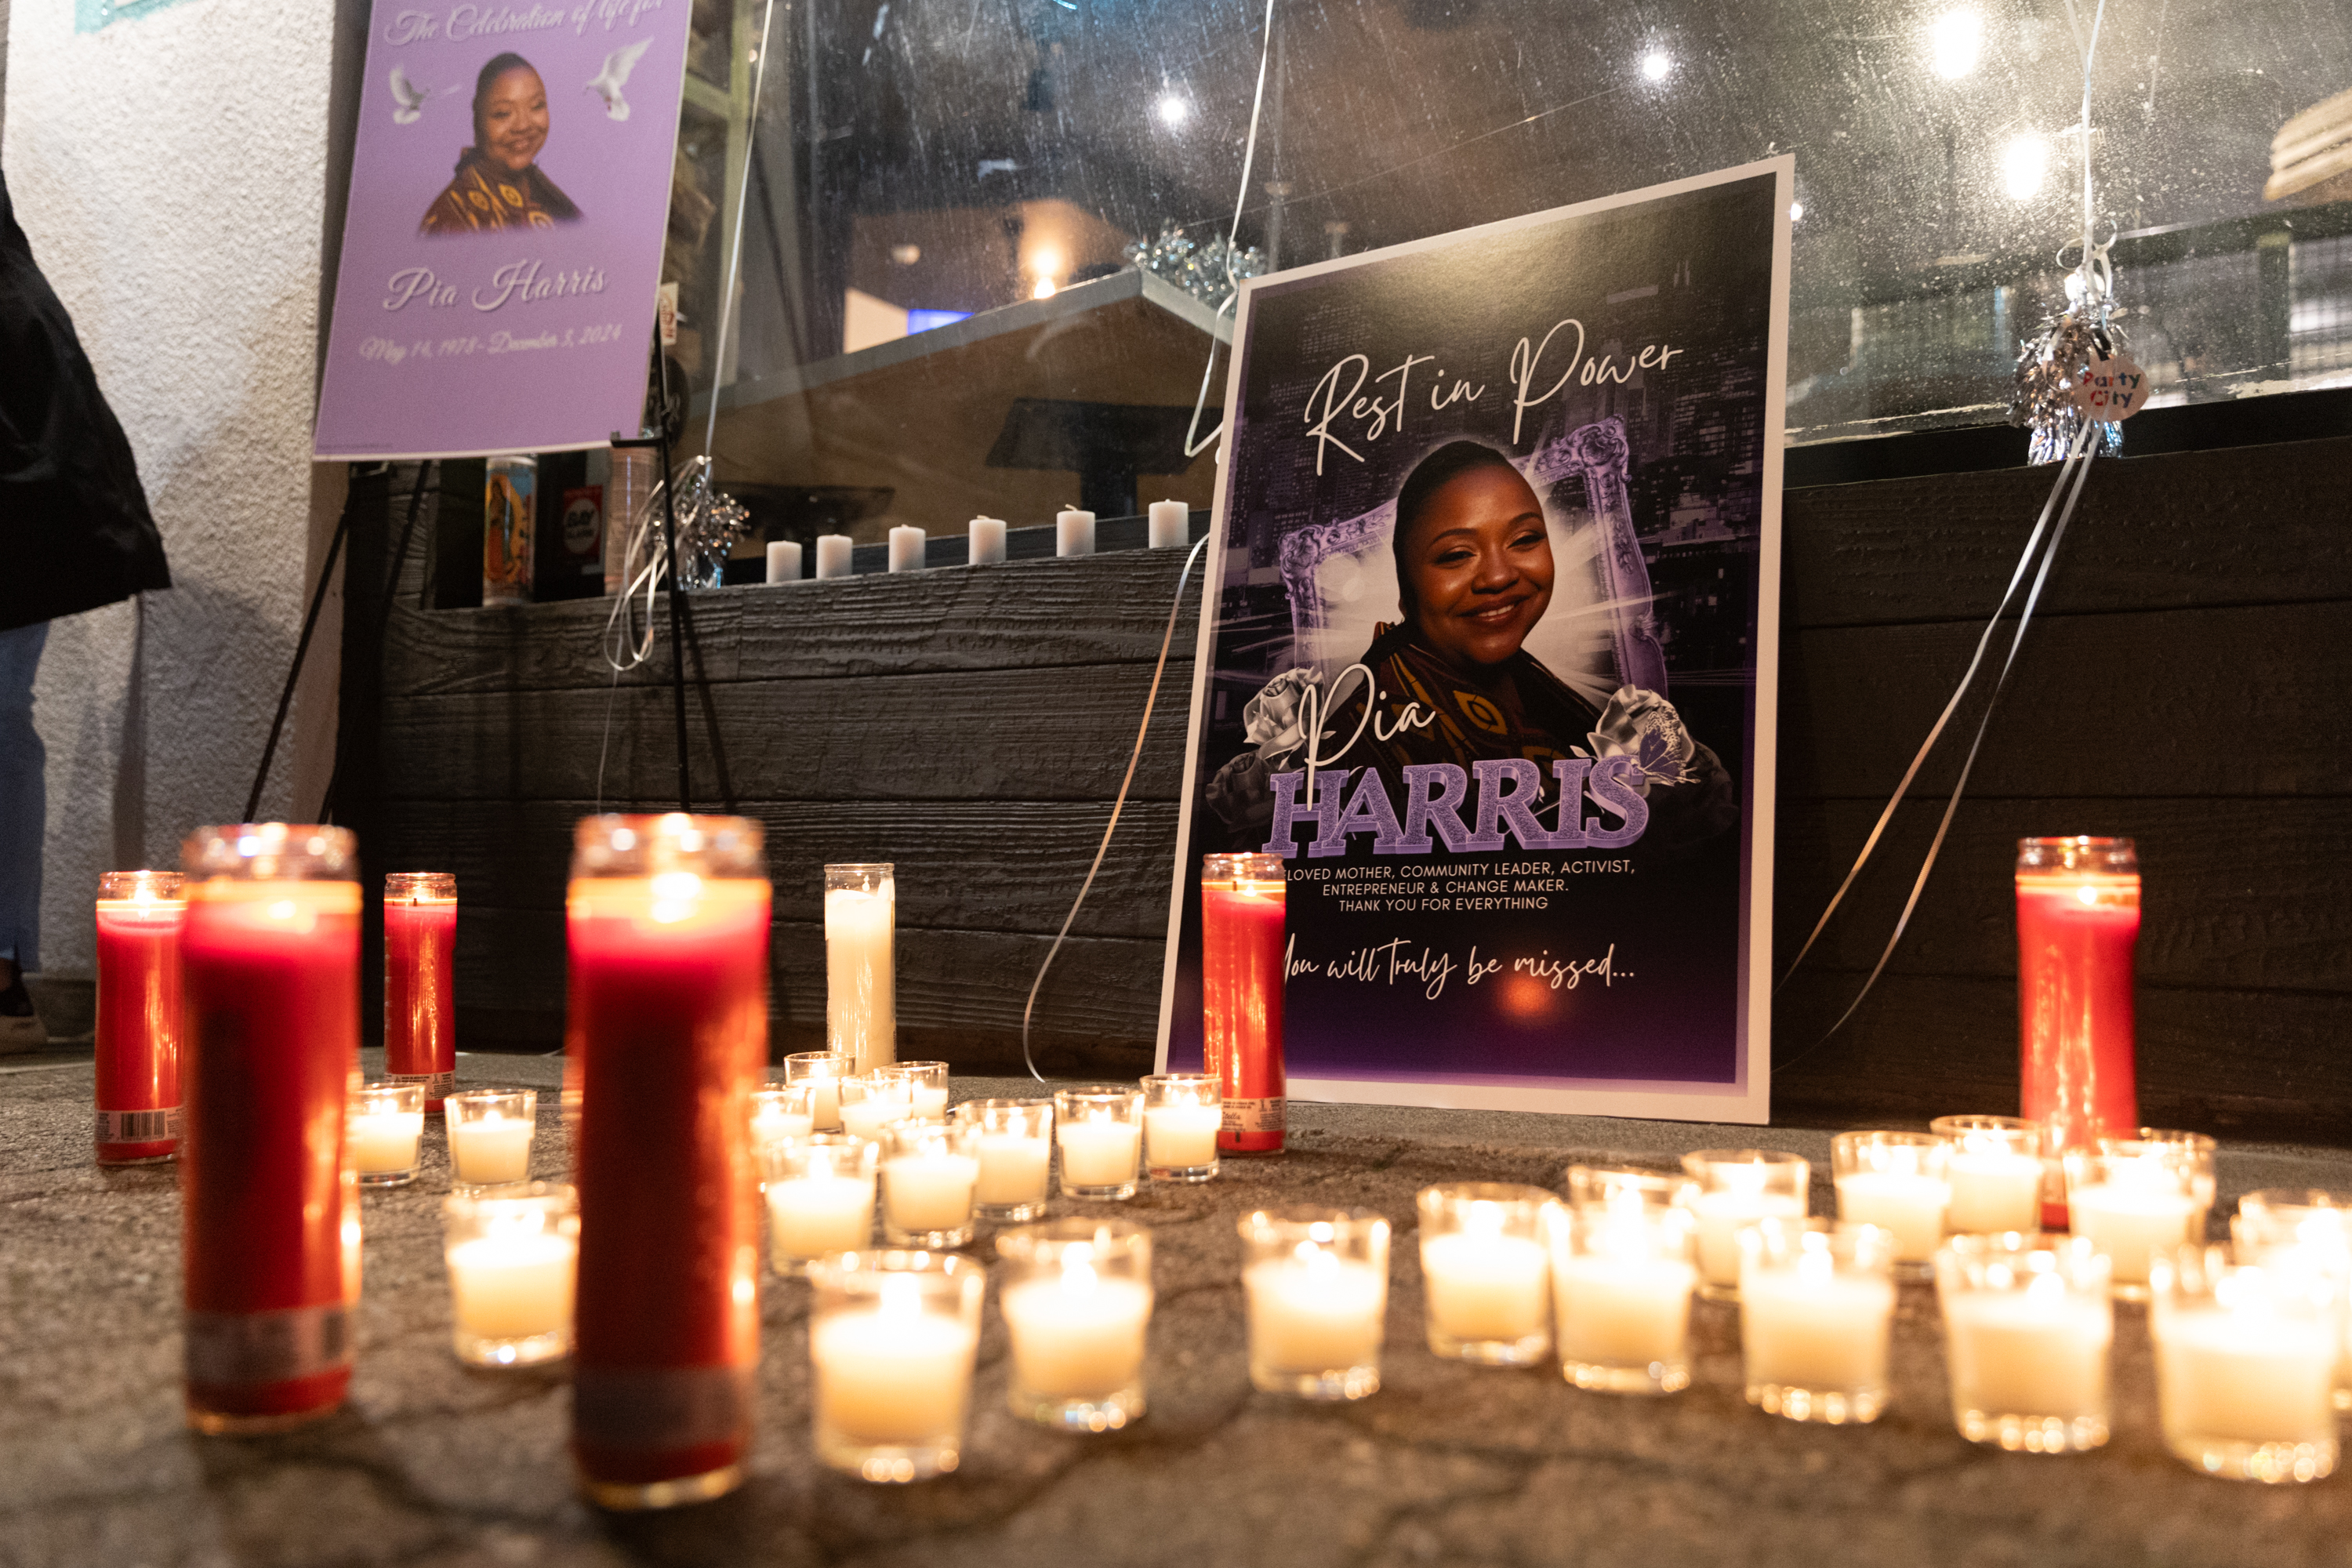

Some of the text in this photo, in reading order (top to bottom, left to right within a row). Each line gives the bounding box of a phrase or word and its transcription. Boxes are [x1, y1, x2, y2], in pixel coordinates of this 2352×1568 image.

[383, 9, 437, 46] The
[446, 3, 566, 42] Celebration
[383, 259, 608, 312] Pia Harris
[359, 336, 407, 365] May
[487, 329, 557, 354] December
[579, 322, 622, 345] 2024
[1304, 318, 1684, 477] Rest in Power
[2083, 372, 2141, 408] Party City
[1298, 662, 1436, 812] Pia
[1261, 756, 1650, 858] HARRIS
[1284, 859, 1636, 881] LOVED MOTHER, COMMUNITY LEADER, ACTIVIST,
[1323, 879, 1570, 896] ENTREPRENEUR & CHANGE MAKER.
[1339, 896, 1548, 912] THANK YOU FOR EVERYTHING
[1327, 947, 1381, 982] will
[1468, 945, 1503, 985] be
[1514, 943, 1635, 990] missed...
